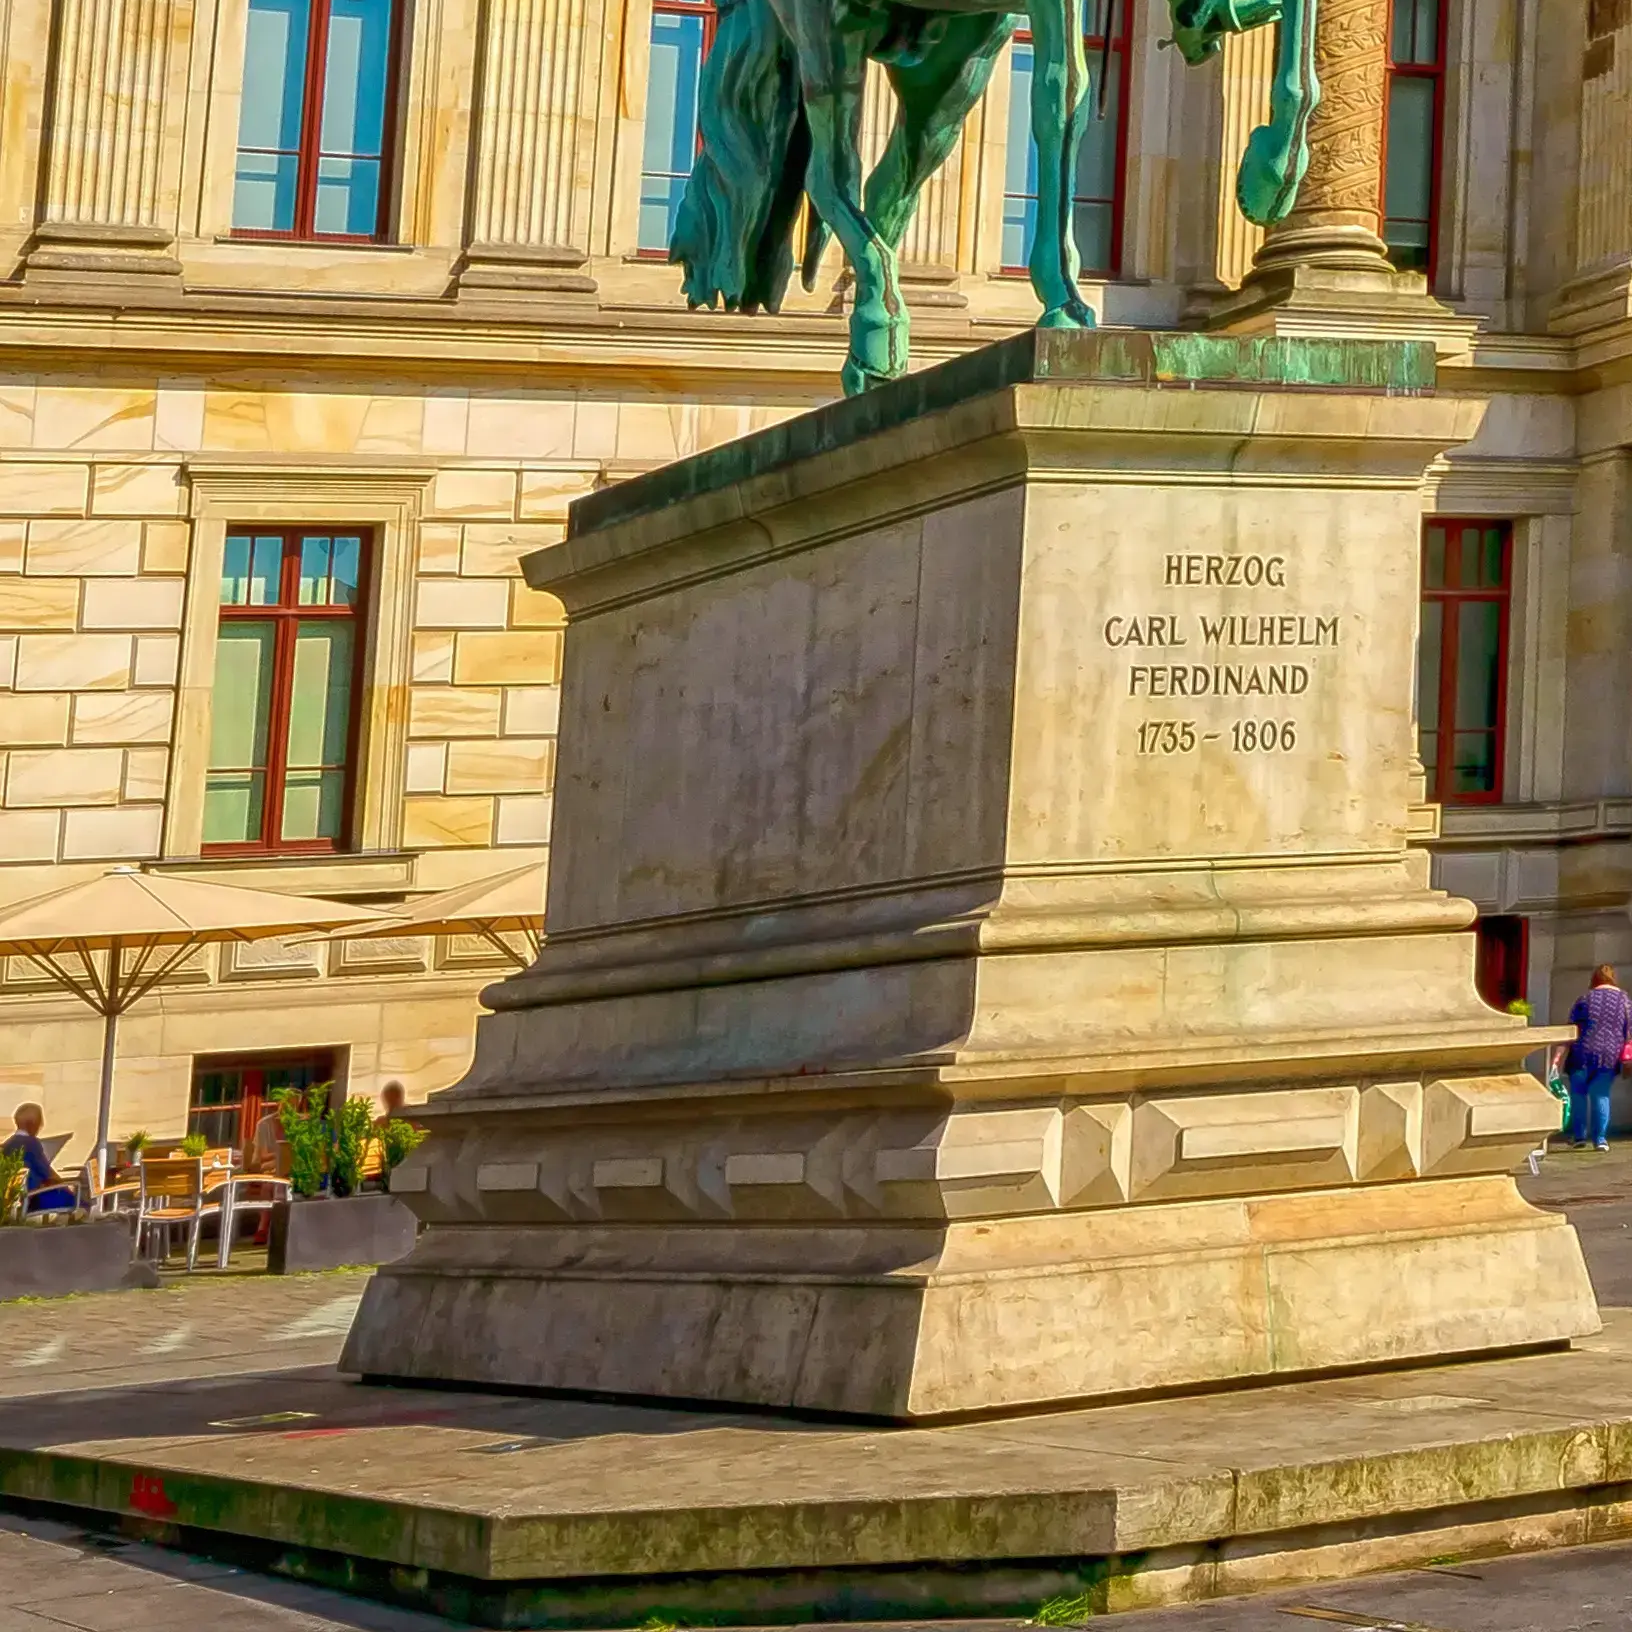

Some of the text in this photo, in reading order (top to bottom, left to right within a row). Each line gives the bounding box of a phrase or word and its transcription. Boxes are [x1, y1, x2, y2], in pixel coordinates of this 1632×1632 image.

[1164, 554, 1286, 587] HERZOG
[1104, 615, 1340, 647] CARL WILHELM
[1128, 664, 1309, 696] FERDINAND
[1137, 721, 1196, 754] 1735
[1231, 720, 1297, 753] 1806
